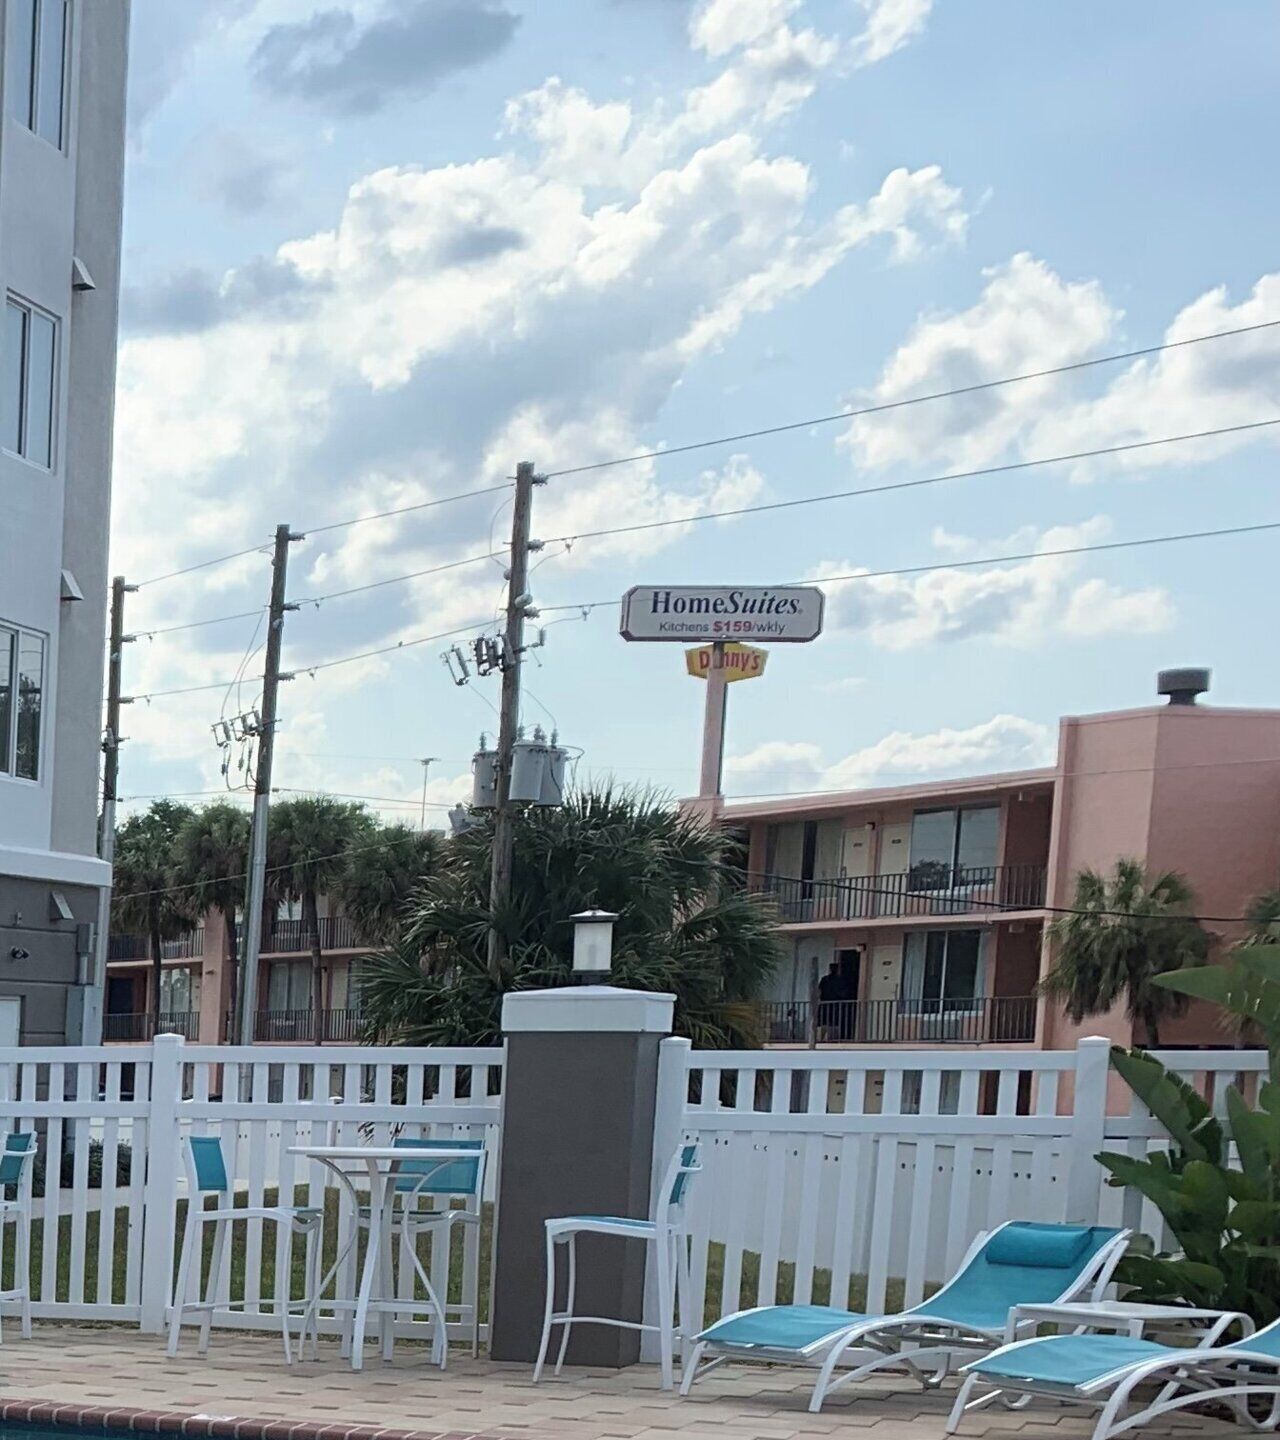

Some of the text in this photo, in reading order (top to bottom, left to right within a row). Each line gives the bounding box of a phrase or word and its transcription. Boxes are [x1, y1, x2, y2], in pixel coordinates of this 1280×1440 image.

[650, 591, 801, 614] HomeSuites
[659, 621, 709, 633] Kitchens
[699, 650, 760, 672] Dnny's
